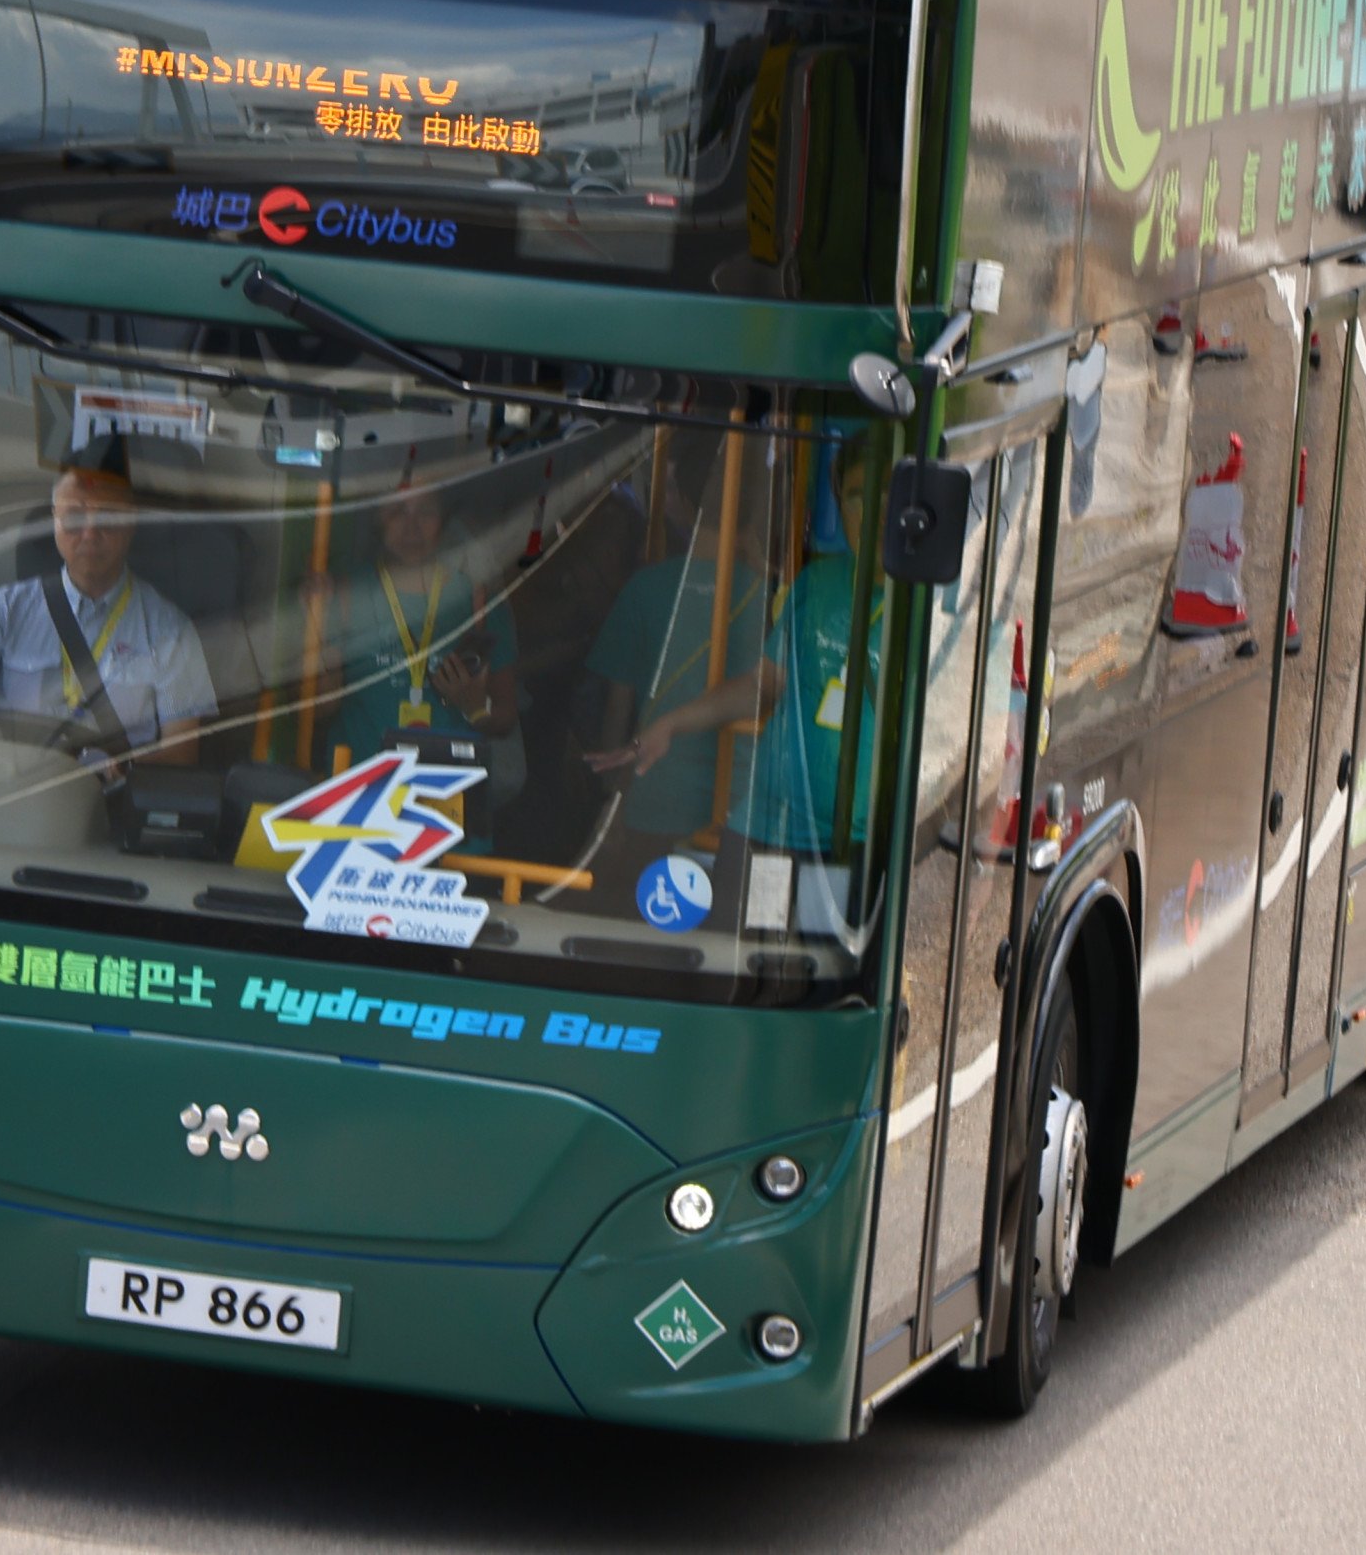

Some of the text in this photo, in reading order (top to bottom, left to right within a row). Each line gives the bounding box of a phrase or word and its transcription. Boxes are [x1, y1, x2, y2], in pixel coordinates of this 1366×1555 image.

[316, 100, 403, 142] 零排放
[171, 185, 459, 249] 城巴 Citybus
[240, 977, 662, 1054] Hydrogen Bus
[121, 1270, 305, 1334] RP 866
[658, 1323, 698, 1345] GAS
